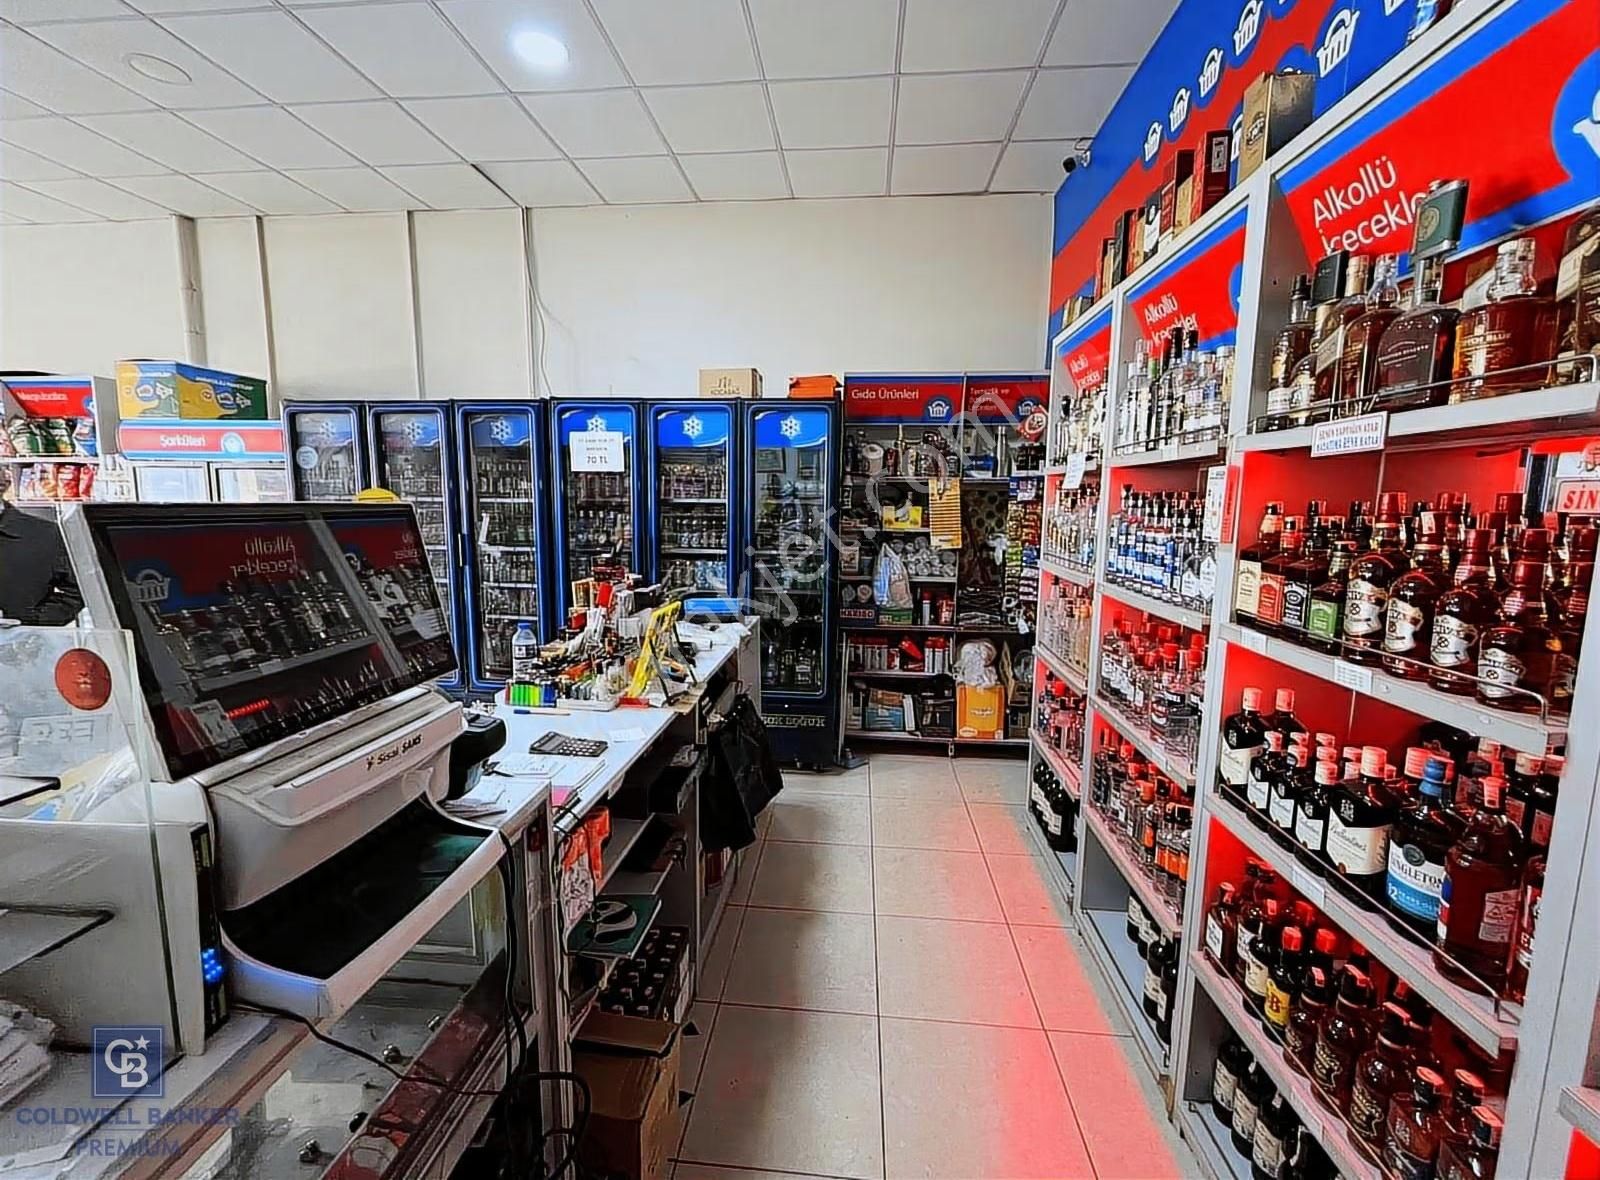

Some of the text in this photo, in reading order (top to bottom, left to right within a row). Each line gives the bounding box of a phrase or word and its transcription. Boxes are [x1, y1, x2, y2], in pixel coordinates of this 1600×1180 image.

[1313, 155, 1397, 229] Alkollü
[1144, 292, 1178, 326] Alkollü
[851, 387, 920, 400] Gıda Ürünleri
